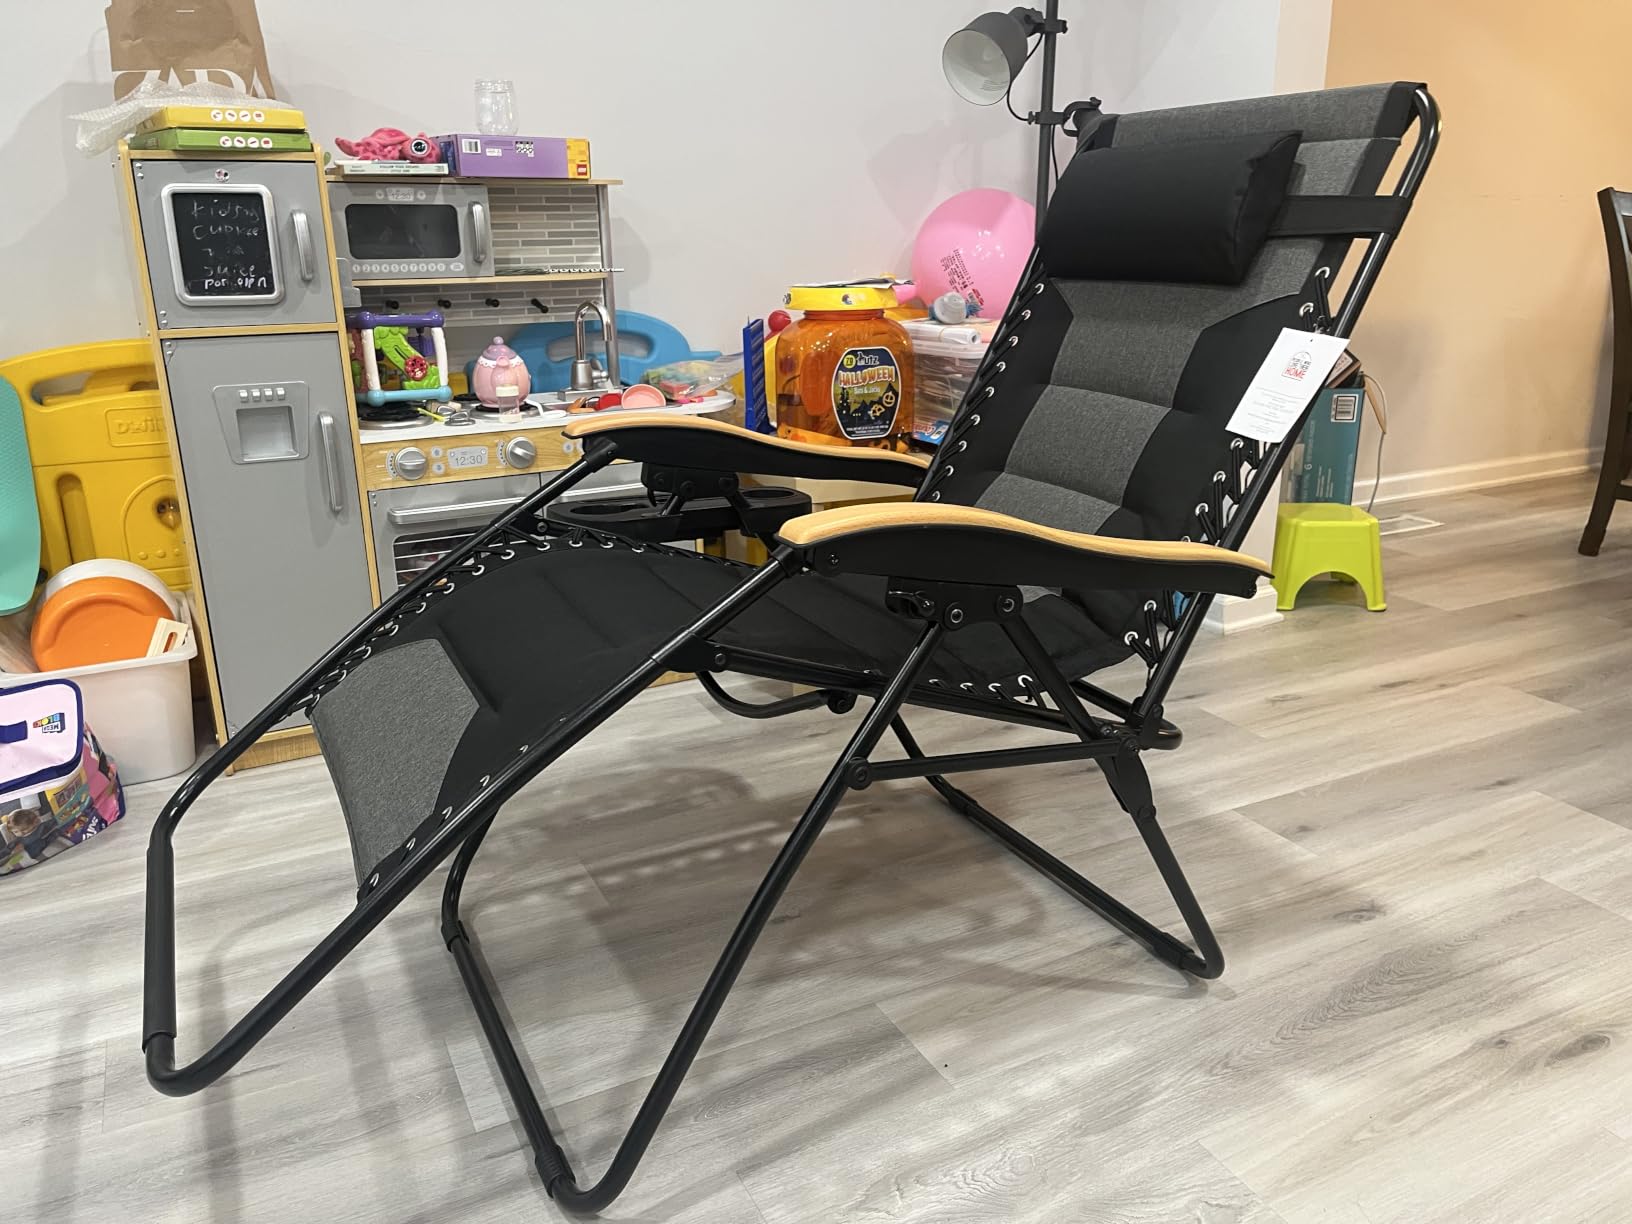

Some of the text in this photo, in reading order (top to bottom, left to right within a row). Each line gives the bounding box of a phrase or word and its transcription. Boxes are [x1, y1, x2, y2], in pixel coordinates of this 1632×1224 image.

[838, 366, 896, 387] HALLOWEEN
[1284, 367, 1306, 379] HOME
[455, 454, 483, 466] 12:30
